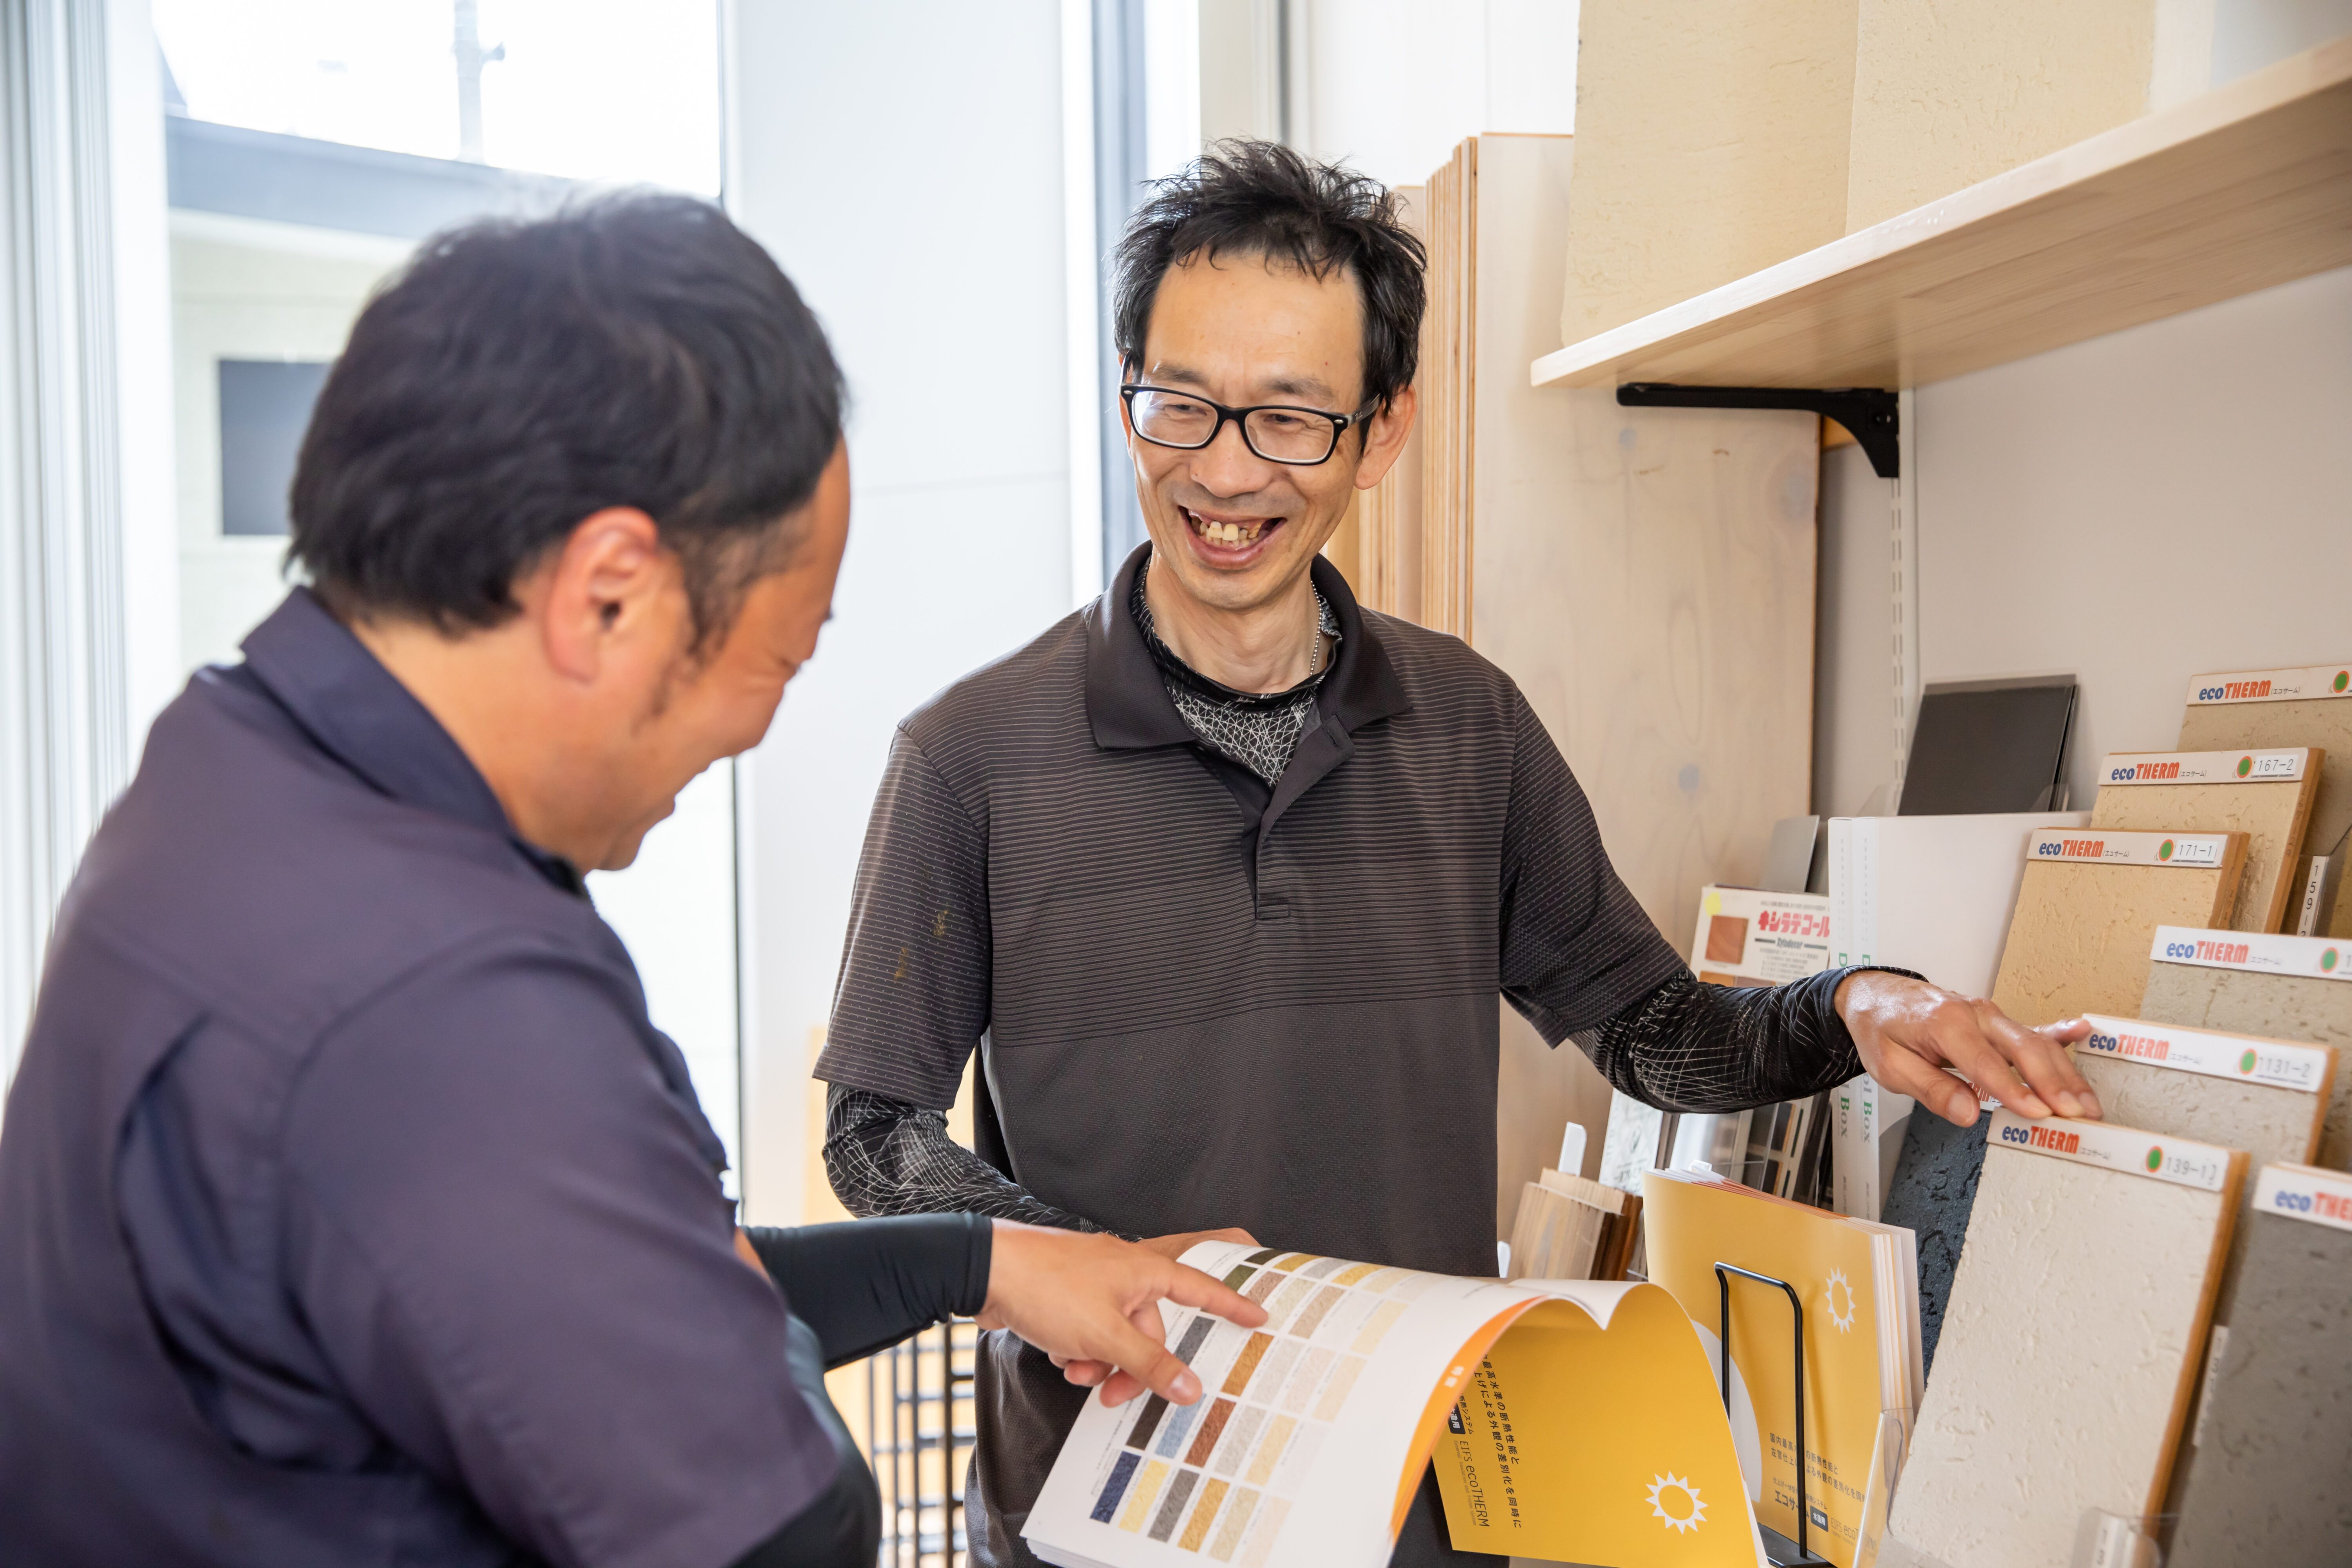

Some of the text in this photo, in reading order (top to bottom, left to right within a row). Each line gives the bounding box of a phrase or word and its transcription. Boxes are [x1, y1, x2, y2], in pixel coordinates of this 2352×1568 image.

[2199, 680, 2271, 701] ecoTHERM
[2111, 762, 2180, 780] ecoTHERM
[2259, 759, 2293, 771] 167-2
[2039, 840, 2104, 857] ecoTHERM
[2180, 844, 2212, 857] 171-1
[1758, 911, 1829, 937] キシラデコール
[2167, 940, 2249, 964] ecoTHERM
[2089, 1034, 2170, 1060] ecoTHERM
[1840, 1096, 1849, 1138] Box
[1864, 1100, 1872, 1143] Box
[2002, 1125, 2080, 1154] ecoTHERM
[1770, 1432, 1838, 1475] 国内最高の断熱性能と
[1459, 1441, 1472, 1462] EIFS
[1466, 1465, 1490, 1527] ecoTHERM
[1771, 1447, 1865, 1502] 左官仕上よる外観の差別化を同
[1830, 1517, 1842, 1533] EIFS
